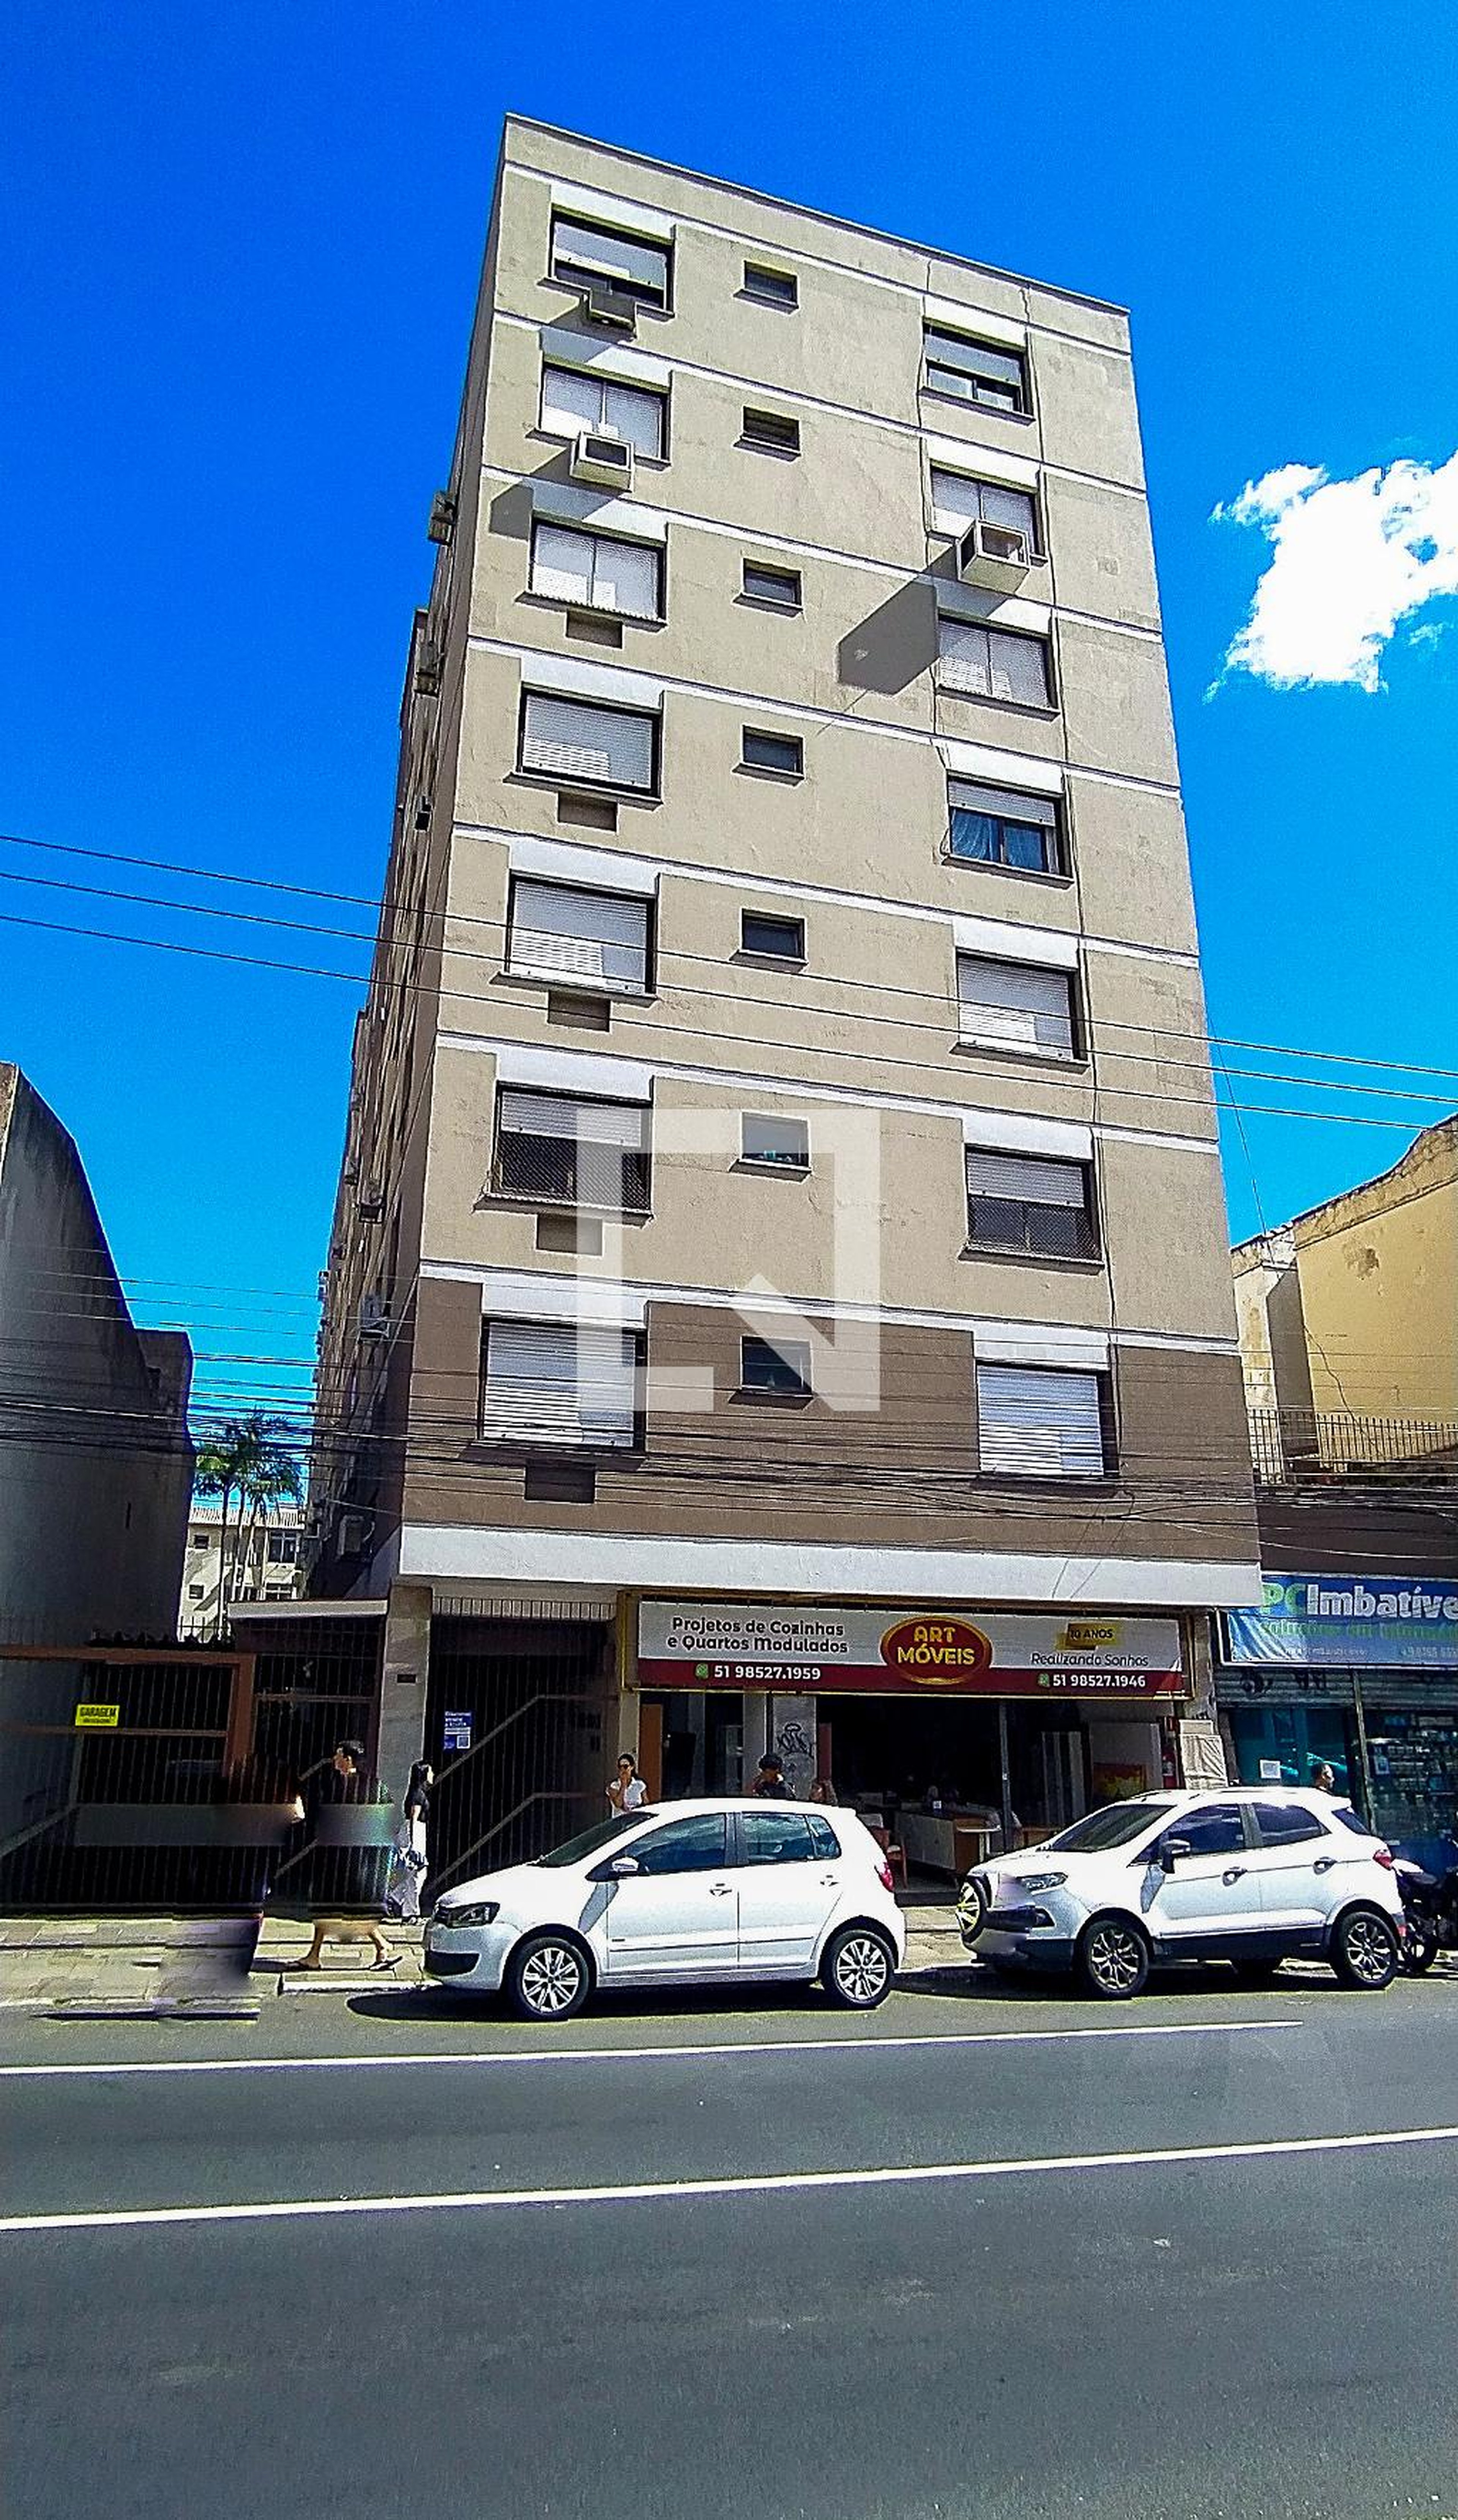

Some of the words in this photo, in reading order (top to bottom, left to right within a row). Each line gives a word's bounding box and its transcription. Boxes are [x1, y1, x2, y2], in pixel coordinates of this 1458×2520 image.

[673, 1617, 740, 1634] Projetos
[746, 1620, 765, 1633] de
[770, 1621, 844, 1636] Cozinhas
[1084, 1629, 1113, 1638] ANOS
[914, 1626, 956, 1643] ART
[667, 1637, 677, 1648] e
[683, 1635, 750, 1651] Quartos
[754, 1637, 848, 1653] Modulados
[897, 1643, 975, 1665] MÓVEIS
[1031, 1653, 1101, 1666] Realizando
[1104, 1654, 1149, 1667] Sonhos
[714, 1665, 729, 1678] 51
[735, 1665, 821, 1679] 98527.1959
[1053, 1674, 1066, 1686] 51
[1070, 1675, 1146, 1687] 98527.1946
